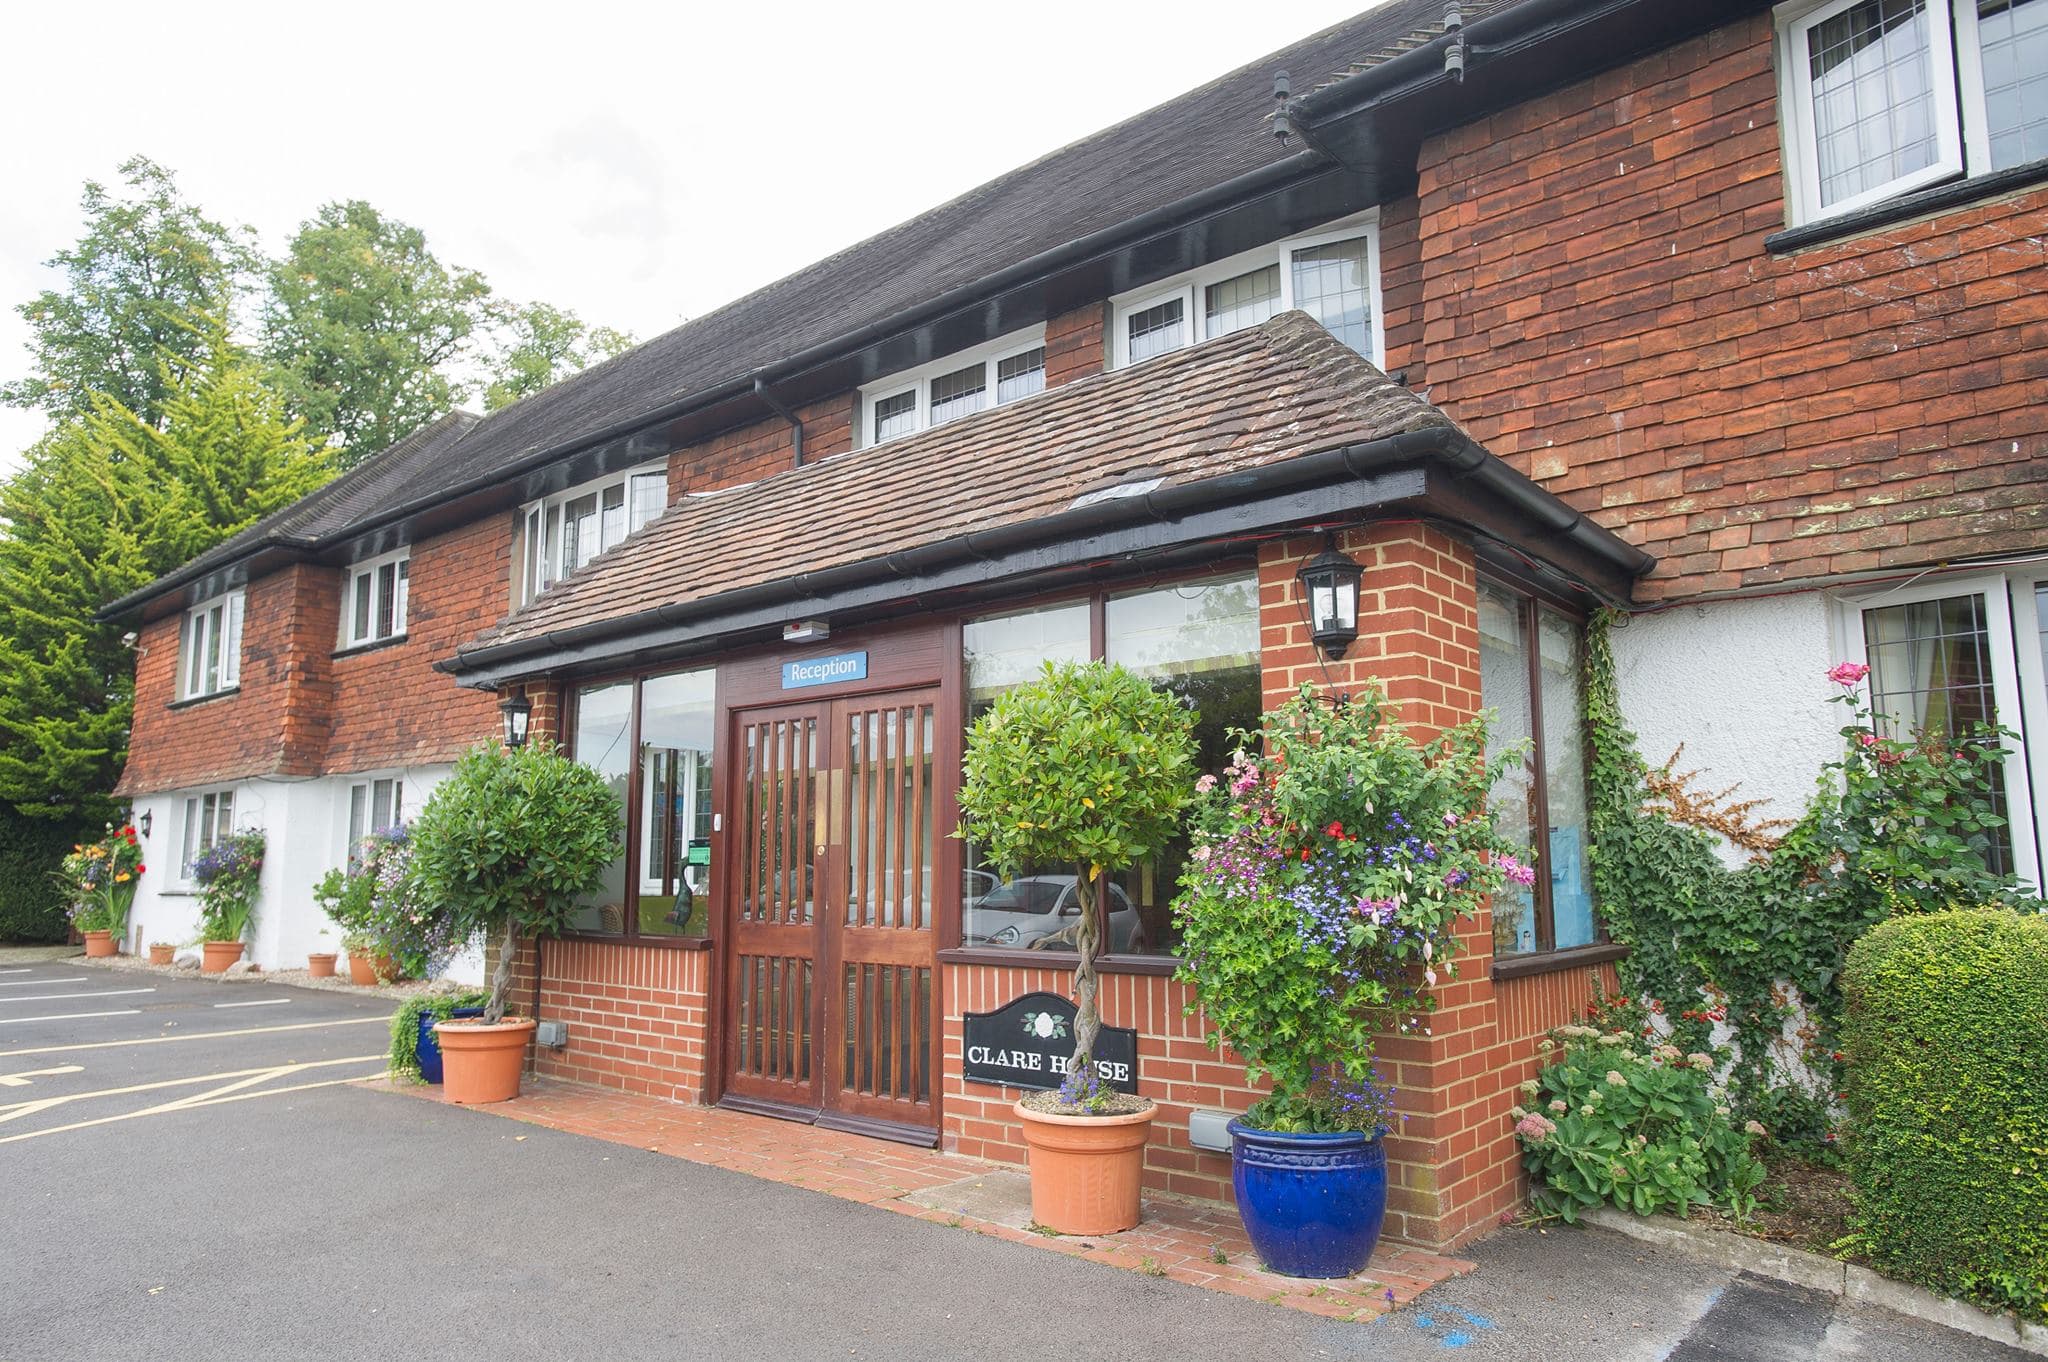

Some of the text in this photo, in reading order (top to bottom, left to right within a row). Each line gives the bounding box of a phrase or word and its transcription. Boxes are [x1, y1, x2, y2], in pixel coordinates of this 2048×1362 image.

[791, 658, 857, 681] Reception
[967, 1046, 1129, 1082] CLARE HSE
